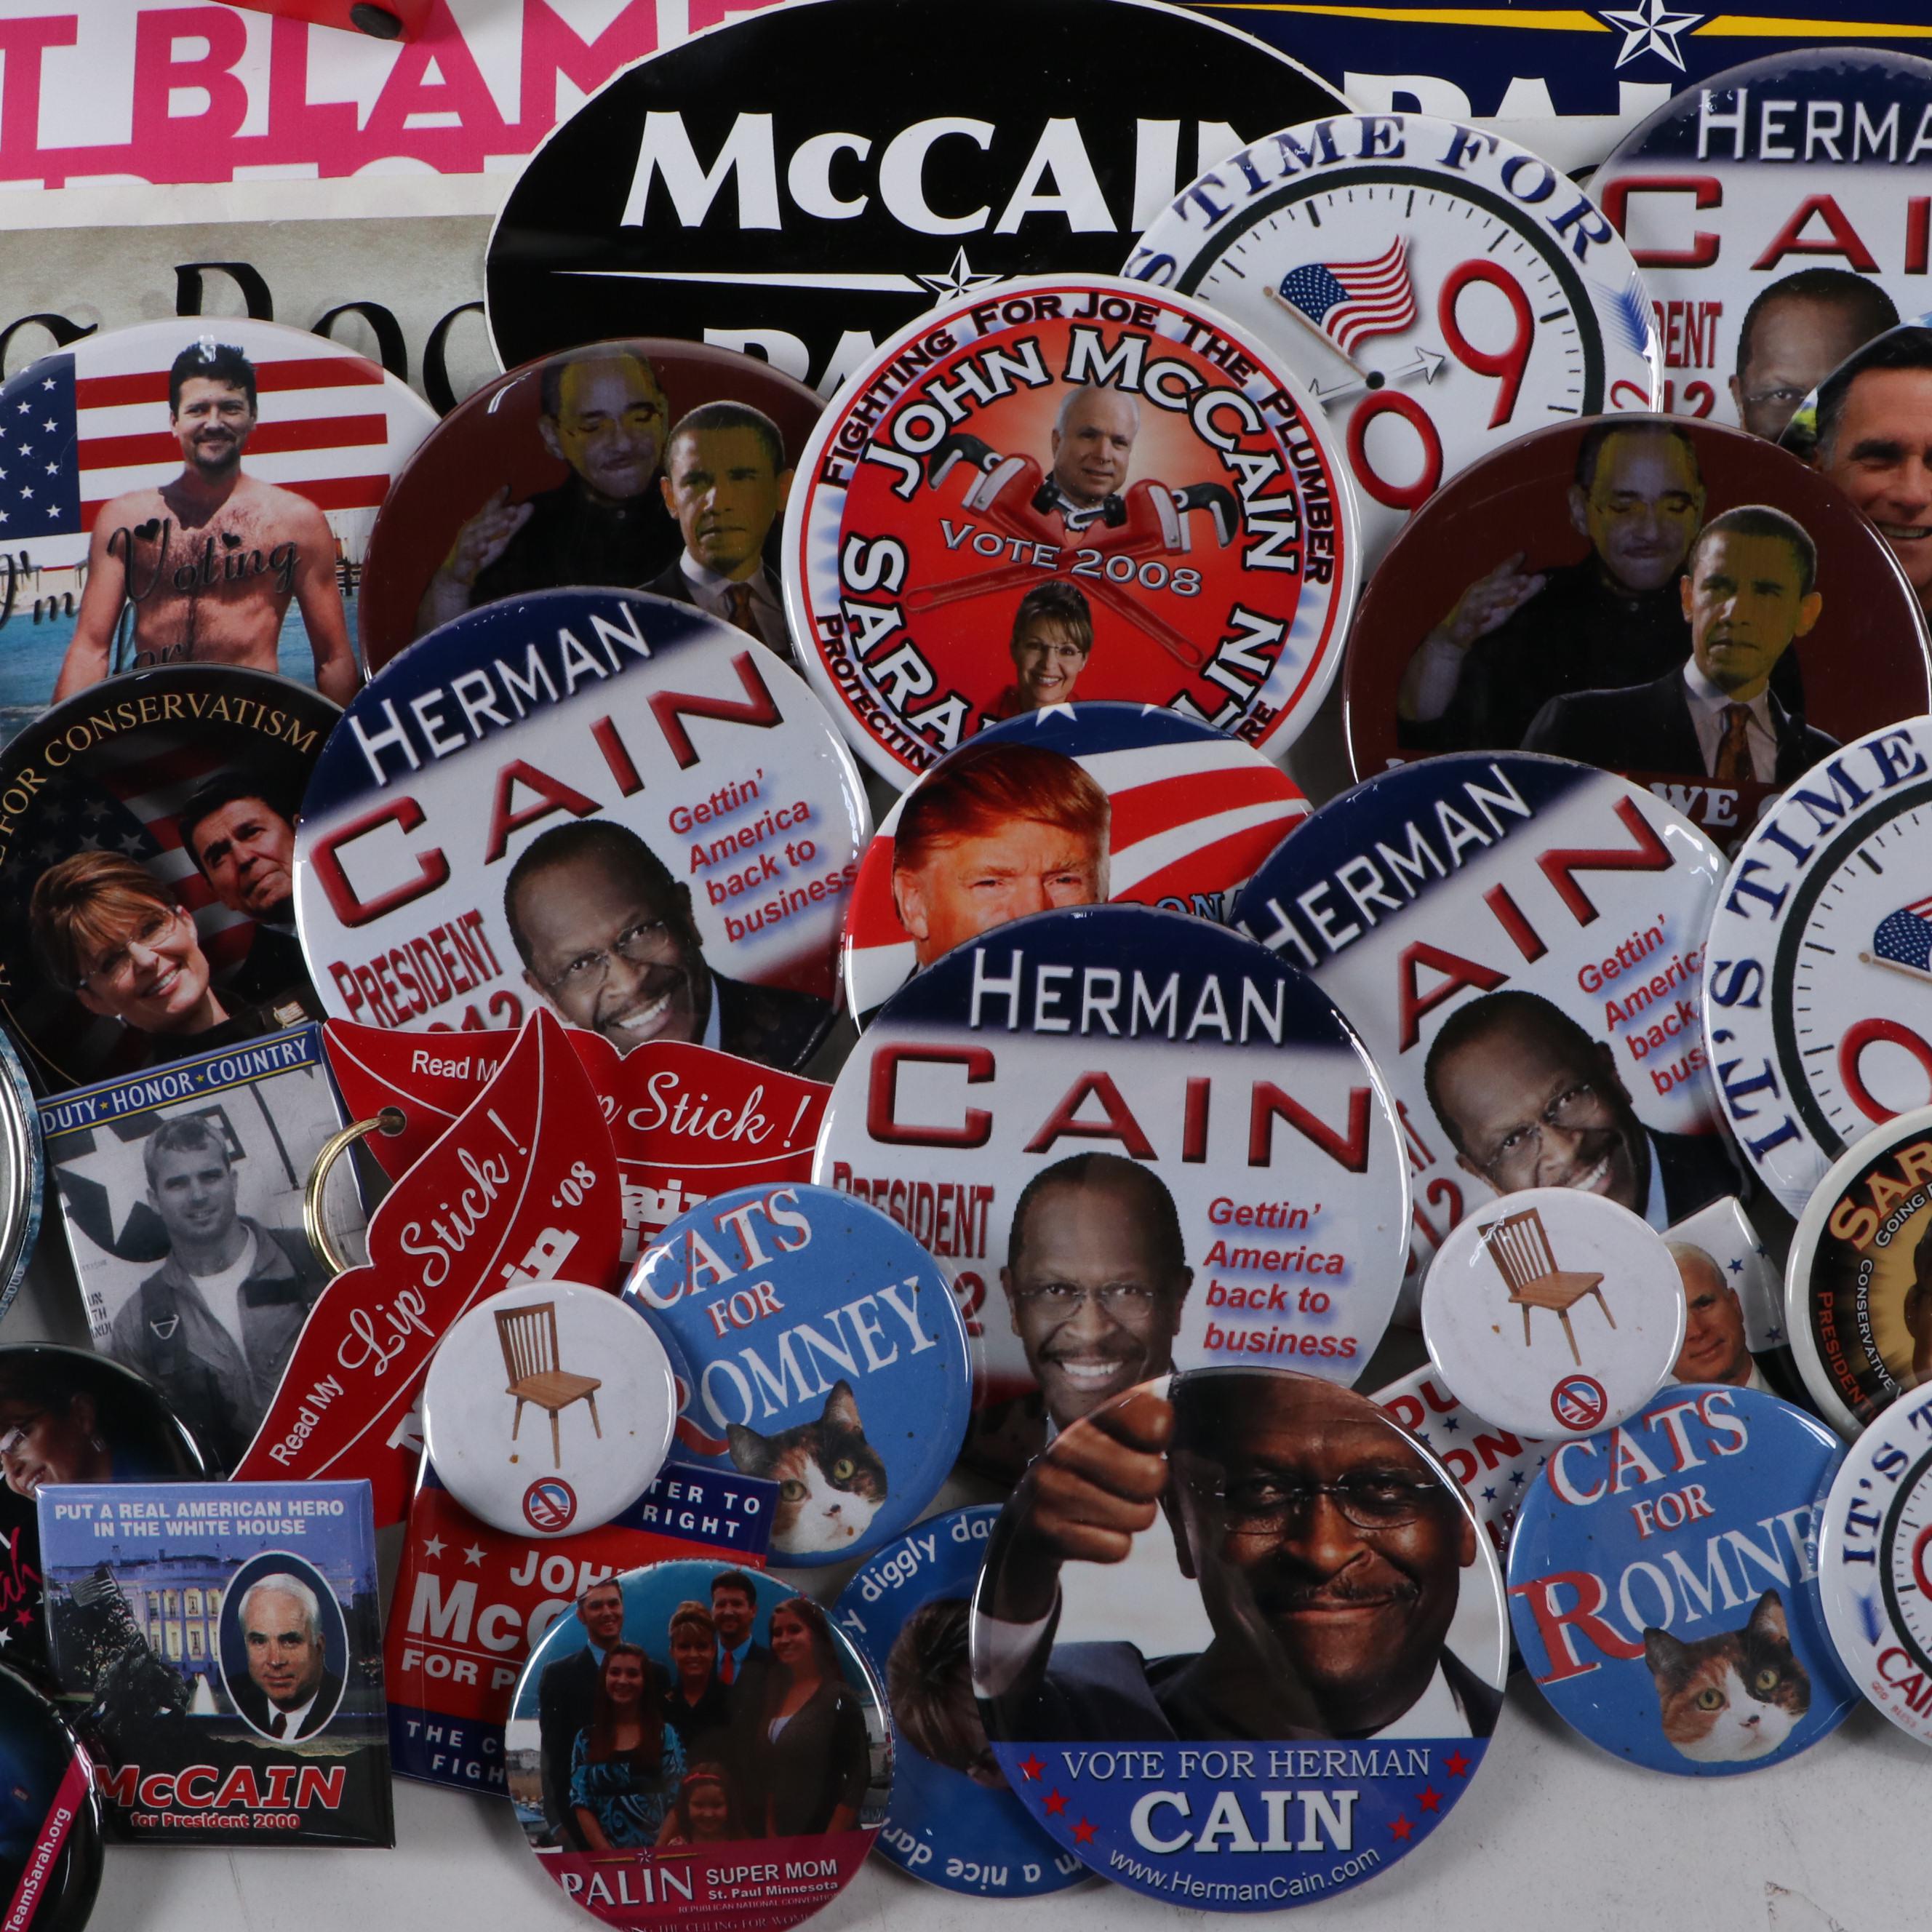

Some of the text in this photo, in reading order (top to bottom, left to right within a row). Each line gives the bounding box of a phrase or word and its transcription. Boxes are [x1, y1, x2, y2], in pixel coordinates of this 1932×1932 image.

[132, 0, 782, 149] BLAM
[1171, 116, 1613, 264] TIME FOR
[820, 327, 958, 490] FIGHTING
[969, 294, 1064, 337] FOR
[1073, 292, 1162, 330] JOE
[1181, 314, 1261, 388] THE
[1257, 388, 1336, 586] PLUMBER
[862, 336, 1052, 501] JOHN
[107, 516, 302, 604] Voting
[940, 517, 1204, 599] VOTE 2008
[840, 532, 1292, 755] SARA LIN
[348, 602, 652, 788] HERMAN
[815, 613, 939, 771] PROTECTIN
[44, 692, 319, 767] CONSERVATISM
[308, 650, 785, 929] CAIN
[668, 768, 765, 835] Gettin'
[690, 800, 811, 873] America
[1239, 762, 1536, 968] HERMAN
[706, 839, 815, 906] back to
[724, 862, 860, 942] business
[1397, 795, 1677, 1055] AIN
[1577, 913, 1666, 994] Gettin'
[1709, 728, 1928, 1164] IT'S TIME
[327, 909, 503, 1028] PRESIDENT
[968, 947, 1286, 1045] HERMAN
[1626, 1000, 1699, 1061] back
[41, 1037, 308, 1133] DUTY HONOR COUNTRY
[411, 1049, 471, 1080] Read
[867, 1041, 1373, 1173] CAIN
[1207, 1197, 1321, 1230] Gettin'
[1828, 1138, 1932, 1252] SAR
[1875, 1193, 1926, 1248] GOING
[633, 1187, 813, 1311] CATS
[1204, 1241, 1345, 1274] America
[706, 1280, 785, 1339] FOR
[1206, 1280, 1330, 1314] back to
[1856, 1259, 1896, 1392] CONSERVATIVE
[1204, 1322, 1358, 1359] business
[268, 1411, 314, 1466] Read
[306, 1372, 345, 1413] My
[337, 1293, 436, 1377] Lip
[1546, 1390, 1749, 1506] CATS
[55, 1500, 344, 1520] PUT A REAL AMERICAN HERO
[94, 1519, 306, 1537] IN THE WHITE HOUSE
[642, 1504, 741, 1540] RIGHT
[724, 1491, 760, 1515] TO
[1629, 1482, 1715, 1541] FOR
[1842, 1441, 1909, 1568] IT'S
[510, 1549, 629, 1597] JOH
[861, 1533, 936, 1602] diggly
[1506, 1498, 1827, 1685] ROMNE
[402, 1648, 478, 1685] FOR
[407, 1720, 464, 1748] THE
[431, 1753, 506, 1782] FIGH
[1062, 1749, 1432, 1781] VOTE FOR HERMAN
[95, 1765, 346, 1810] McCAIN
[131, 1811, 301, 1829] for President 2000
[1130, 1789, 1360, 1853] CAIN
[4, 1807, 71, 1932] TeamSarah.org
[559, 1865, 695, 1907] PALIN
[706, 1859, 837, 1885] SUPER MOM
[708, 1880, 839, 1901] St. Paul Minnesota
[946, 1856, 1008, 1891] nice
[1022, 1862, 1042, 1883] a
[1109, 1846, 1381, 1902] www.HermanCain.com
[678, 1893, 838, 1915] REPUBLICAN NATIONAL CONVENTIO
[741, 1917, 767, 1928] FOR
[771, 1913, 809, 1925] WOM
